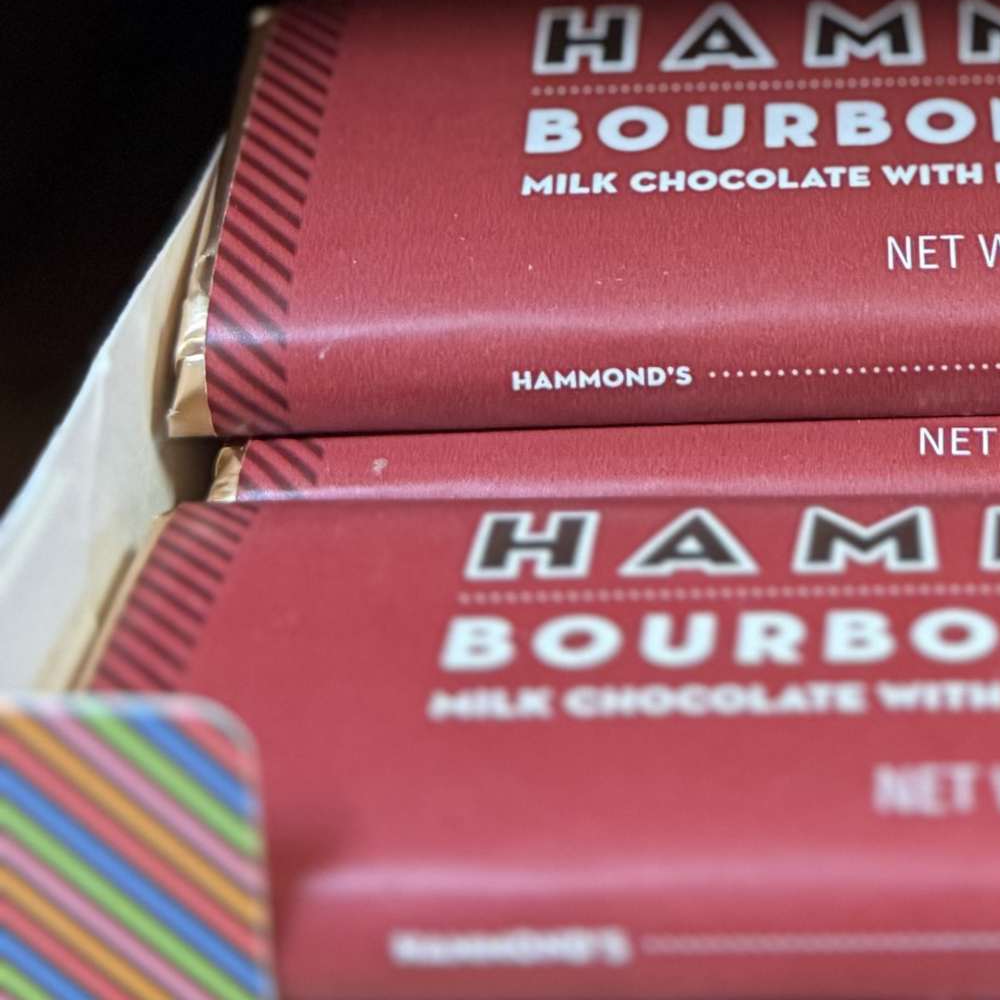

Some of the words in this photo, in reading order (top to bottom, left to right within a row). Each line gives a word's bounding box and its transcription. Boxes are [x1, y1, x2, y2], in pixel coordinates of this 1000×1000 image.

[521, 172, 617, 195] MILK
[630, 166, 870, 192] CHOCOLATE
[882, 163, 983, 185] WITH
[888, 235, 964, 270] NET
[512, 366, 692, 390] HAMMOND'S
[920, 427, 997, 455] NET
[429, 688, 551, 718] MILK
[563, 682, 866, 717] CHOCOLATE
[874, 763, 976, 815] NET
